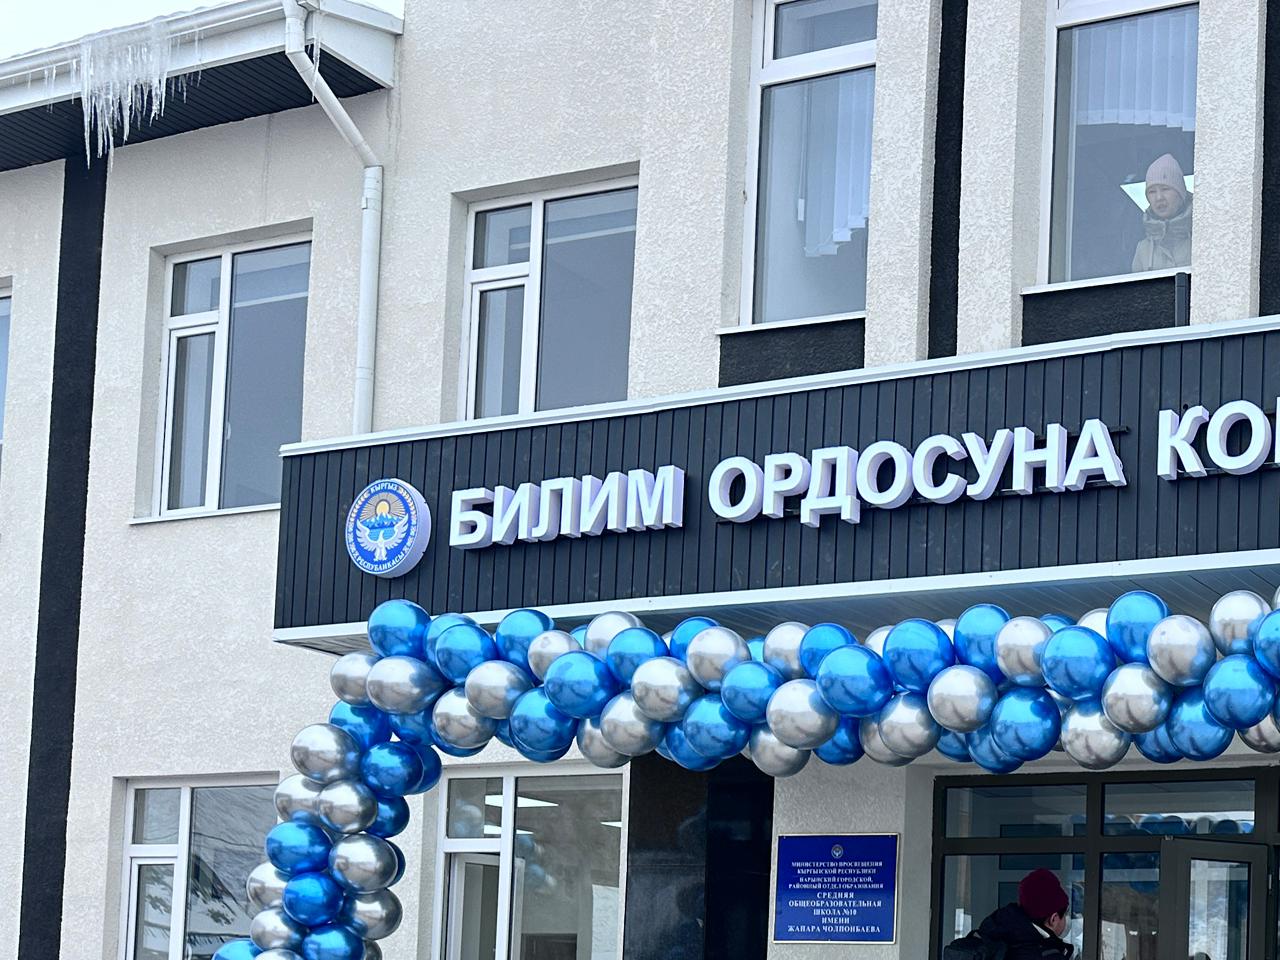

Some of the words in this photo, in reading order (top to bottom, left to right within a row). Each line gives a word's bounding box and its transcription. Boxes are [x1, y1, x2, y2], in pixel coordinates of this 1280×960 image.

[370, 482, 398, 494] КЫРГЫЗ
[449, 464, 686, 550] БИЛИМ
[708, 418, 1128, 529] ОРДОСУНА
[787, 925, 821, 933] ЖАПАРА
[822, 925, 881, 933] ЧОЛПОНБАЕВА
